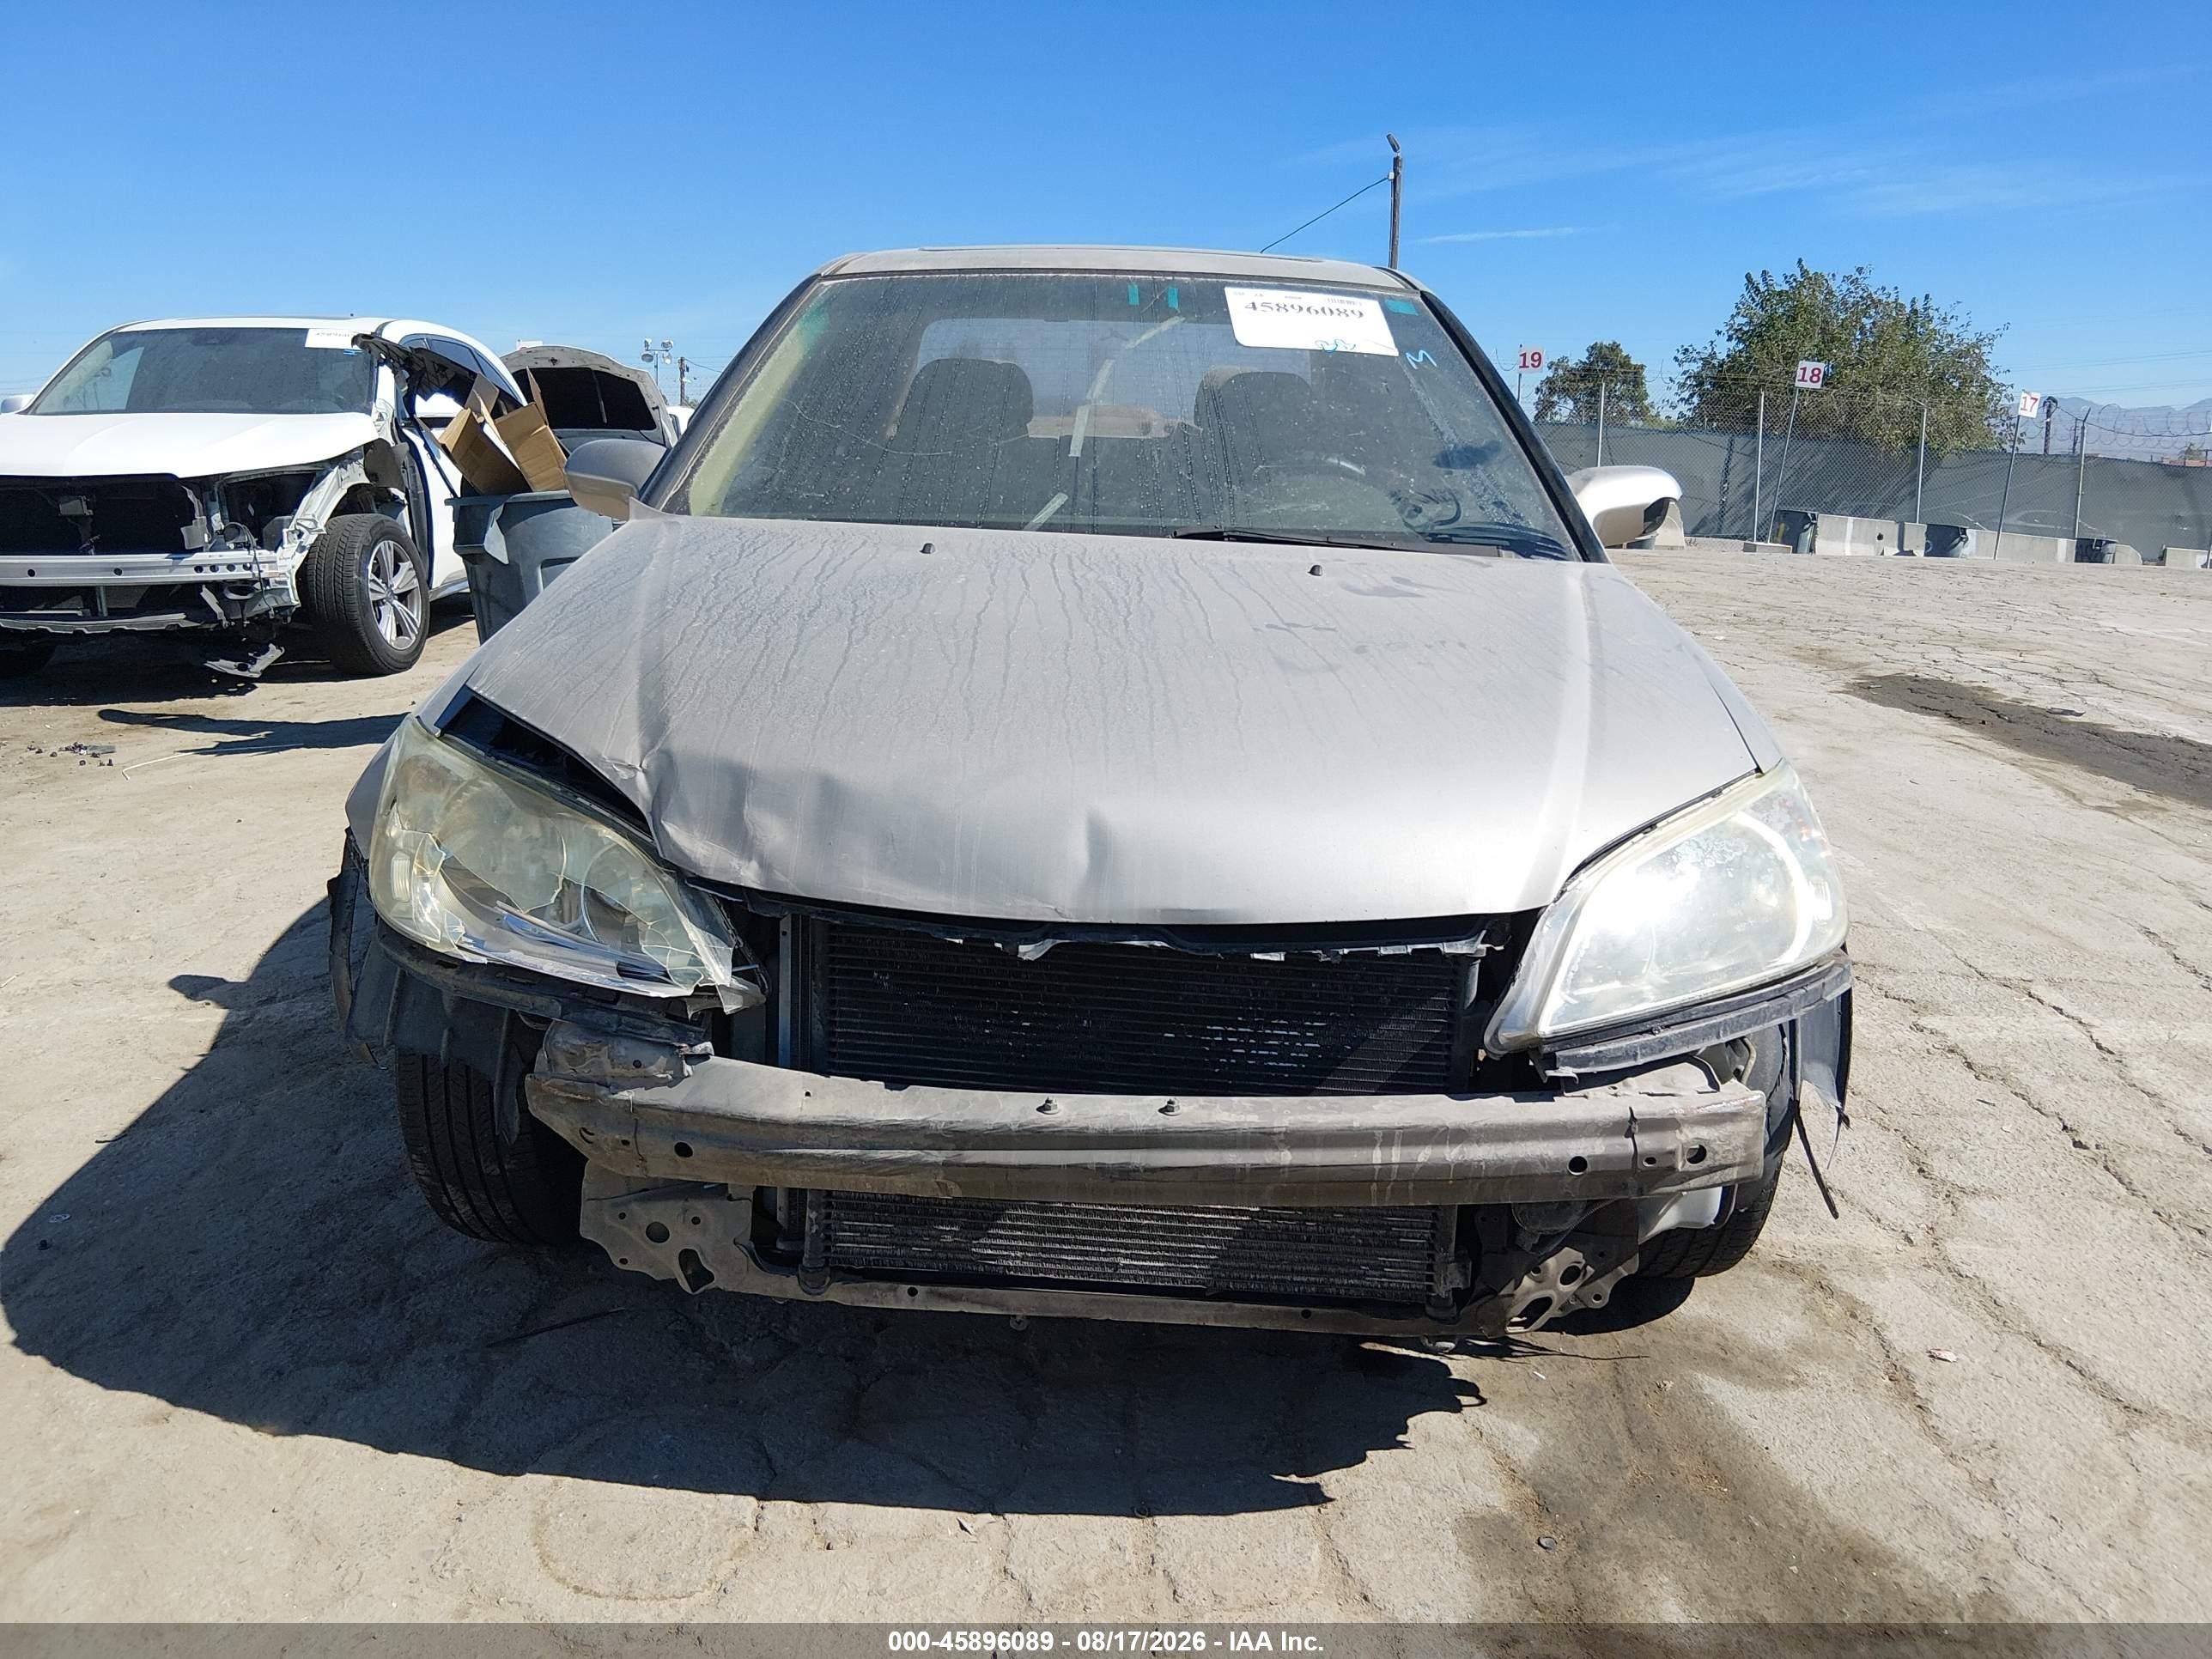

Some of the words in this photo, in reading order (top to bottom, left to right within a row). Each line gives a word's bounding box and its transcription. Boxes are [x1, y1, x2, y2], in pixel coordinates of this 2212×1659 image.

[1245, 301, 1364, 319] 45896089
[1519, 352, 1542, 368] 19
[1797, 367, 1821, 384] 18
[2021, 396, 2039, 413] 17
